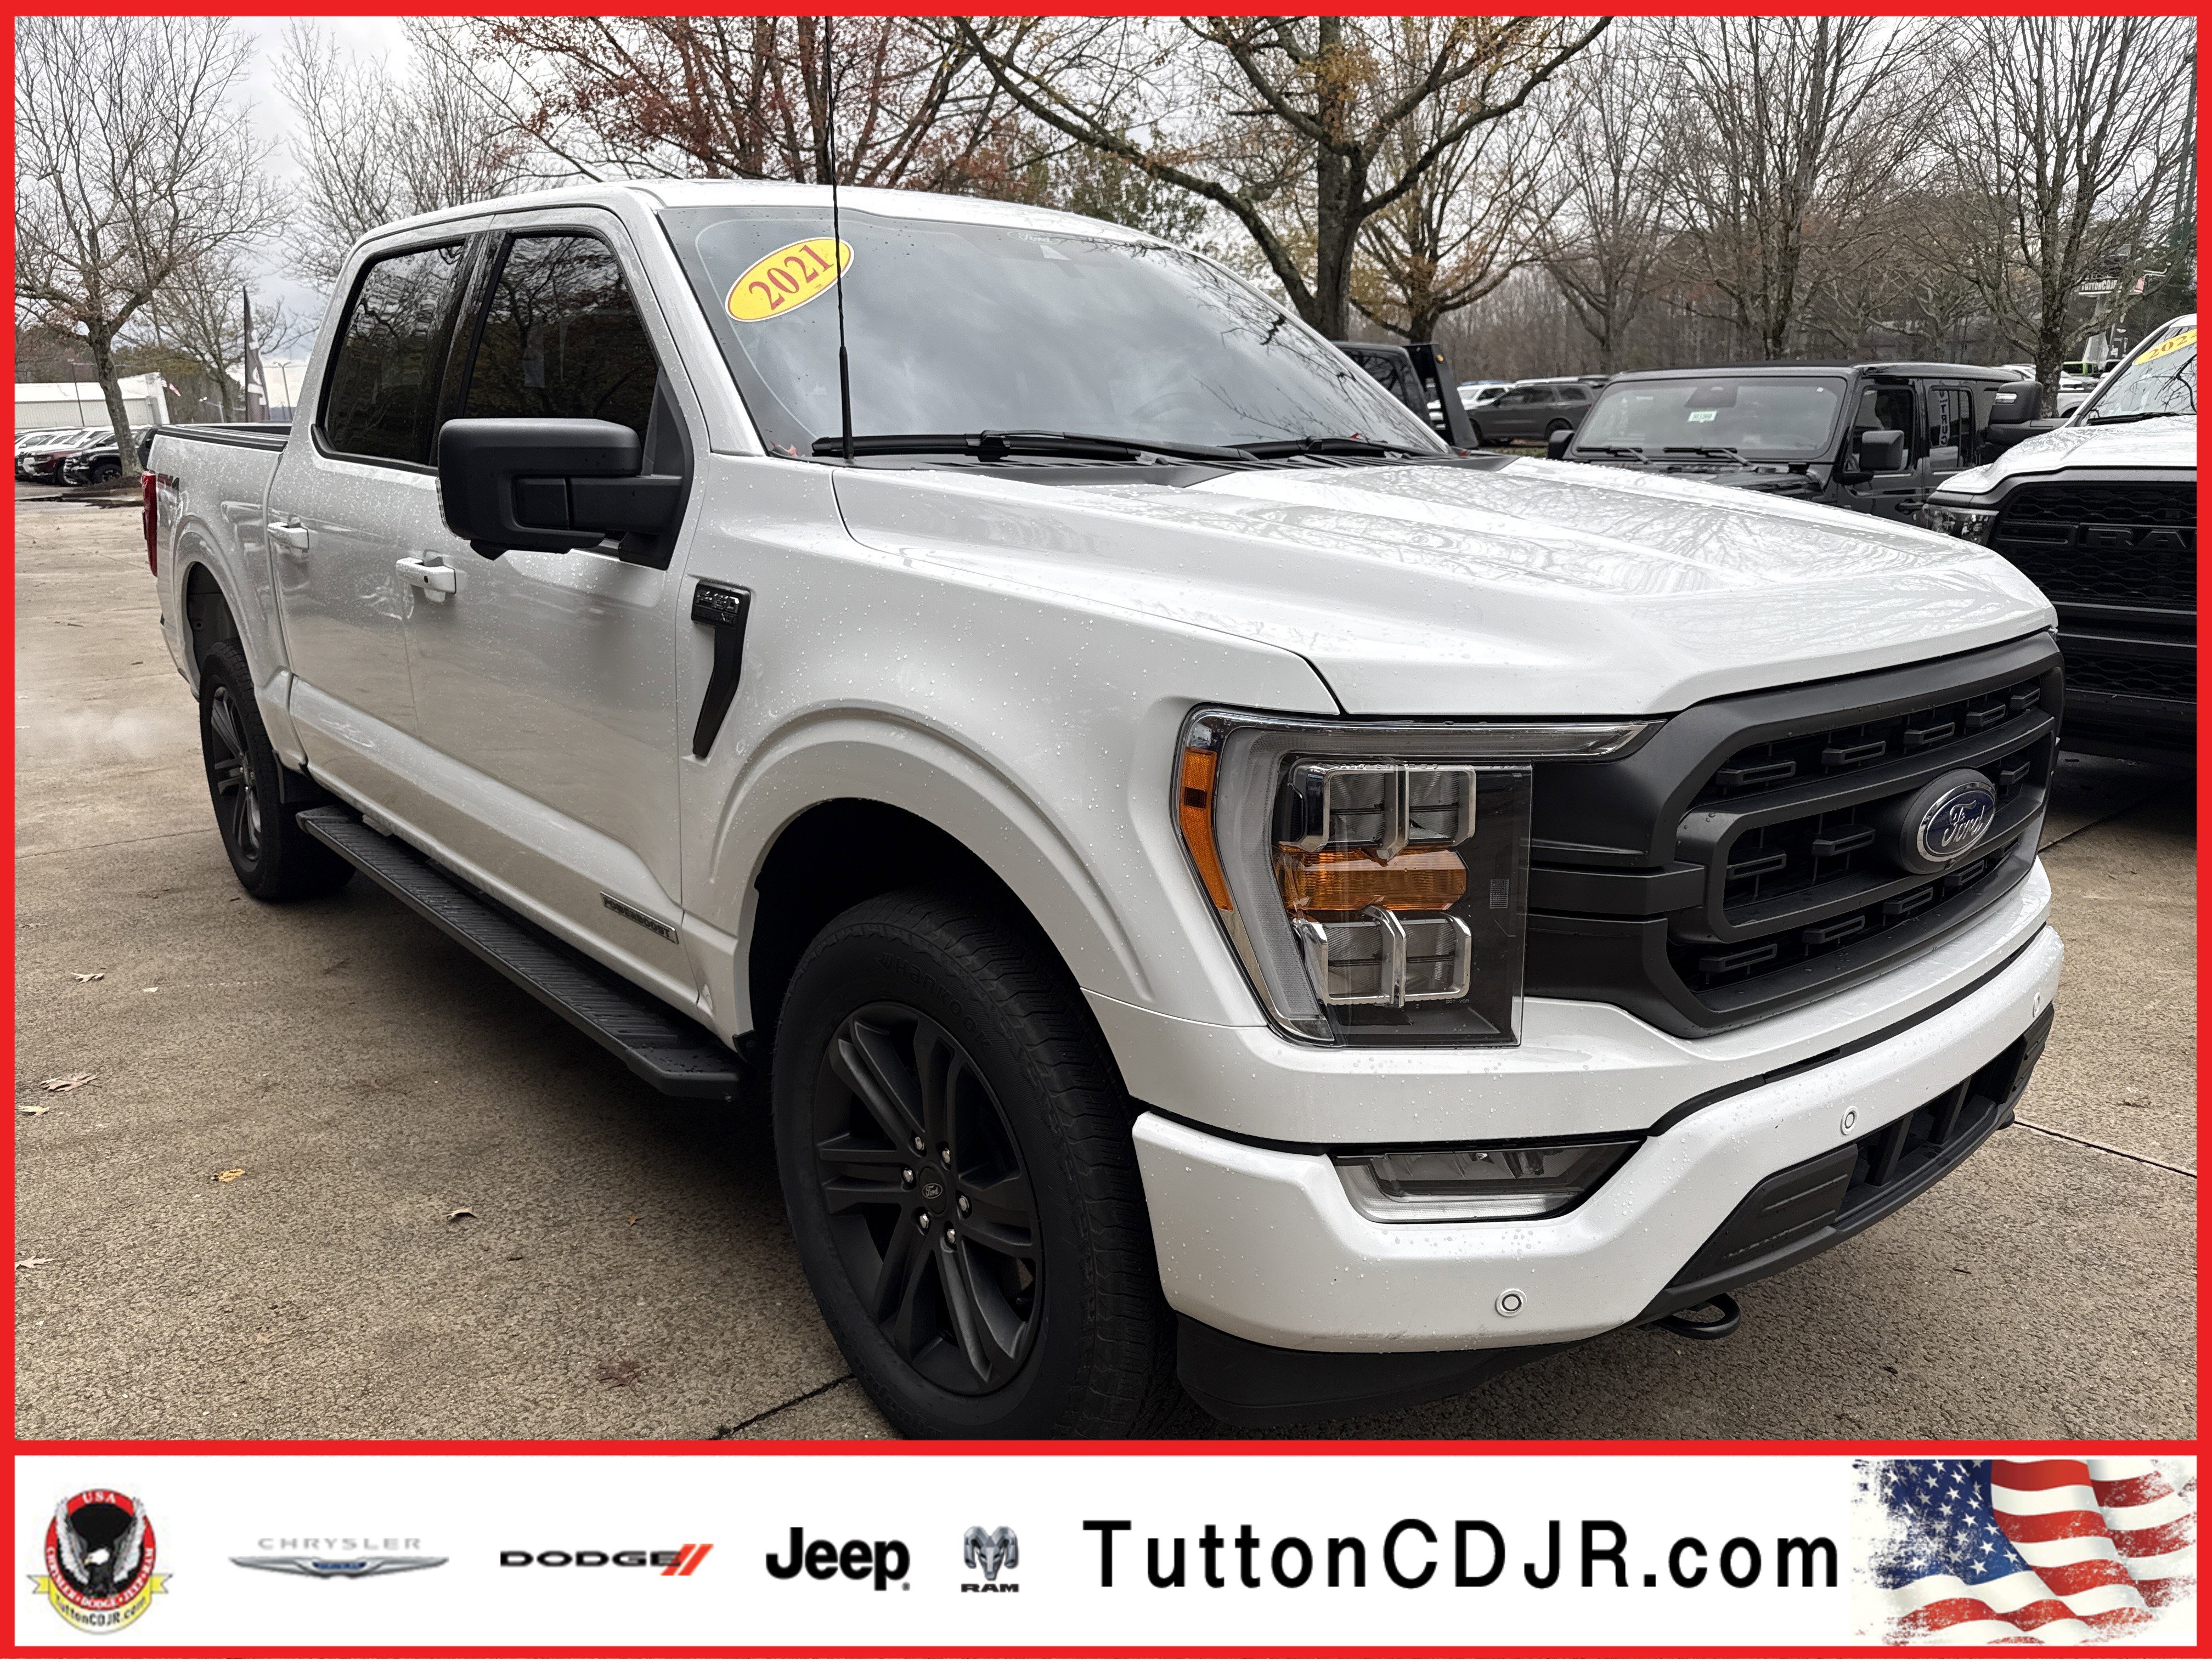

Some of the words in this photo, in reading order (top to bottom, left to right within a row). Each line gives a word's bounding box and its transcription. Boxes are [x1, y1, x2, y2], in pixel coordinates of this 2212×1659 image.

[748, 245, 834, 311] 2021
[2086, 527, 2197, 549] RA
[1941, 799, 1986, 847] Ford
[926, 1185, 939, 1197] Ford
